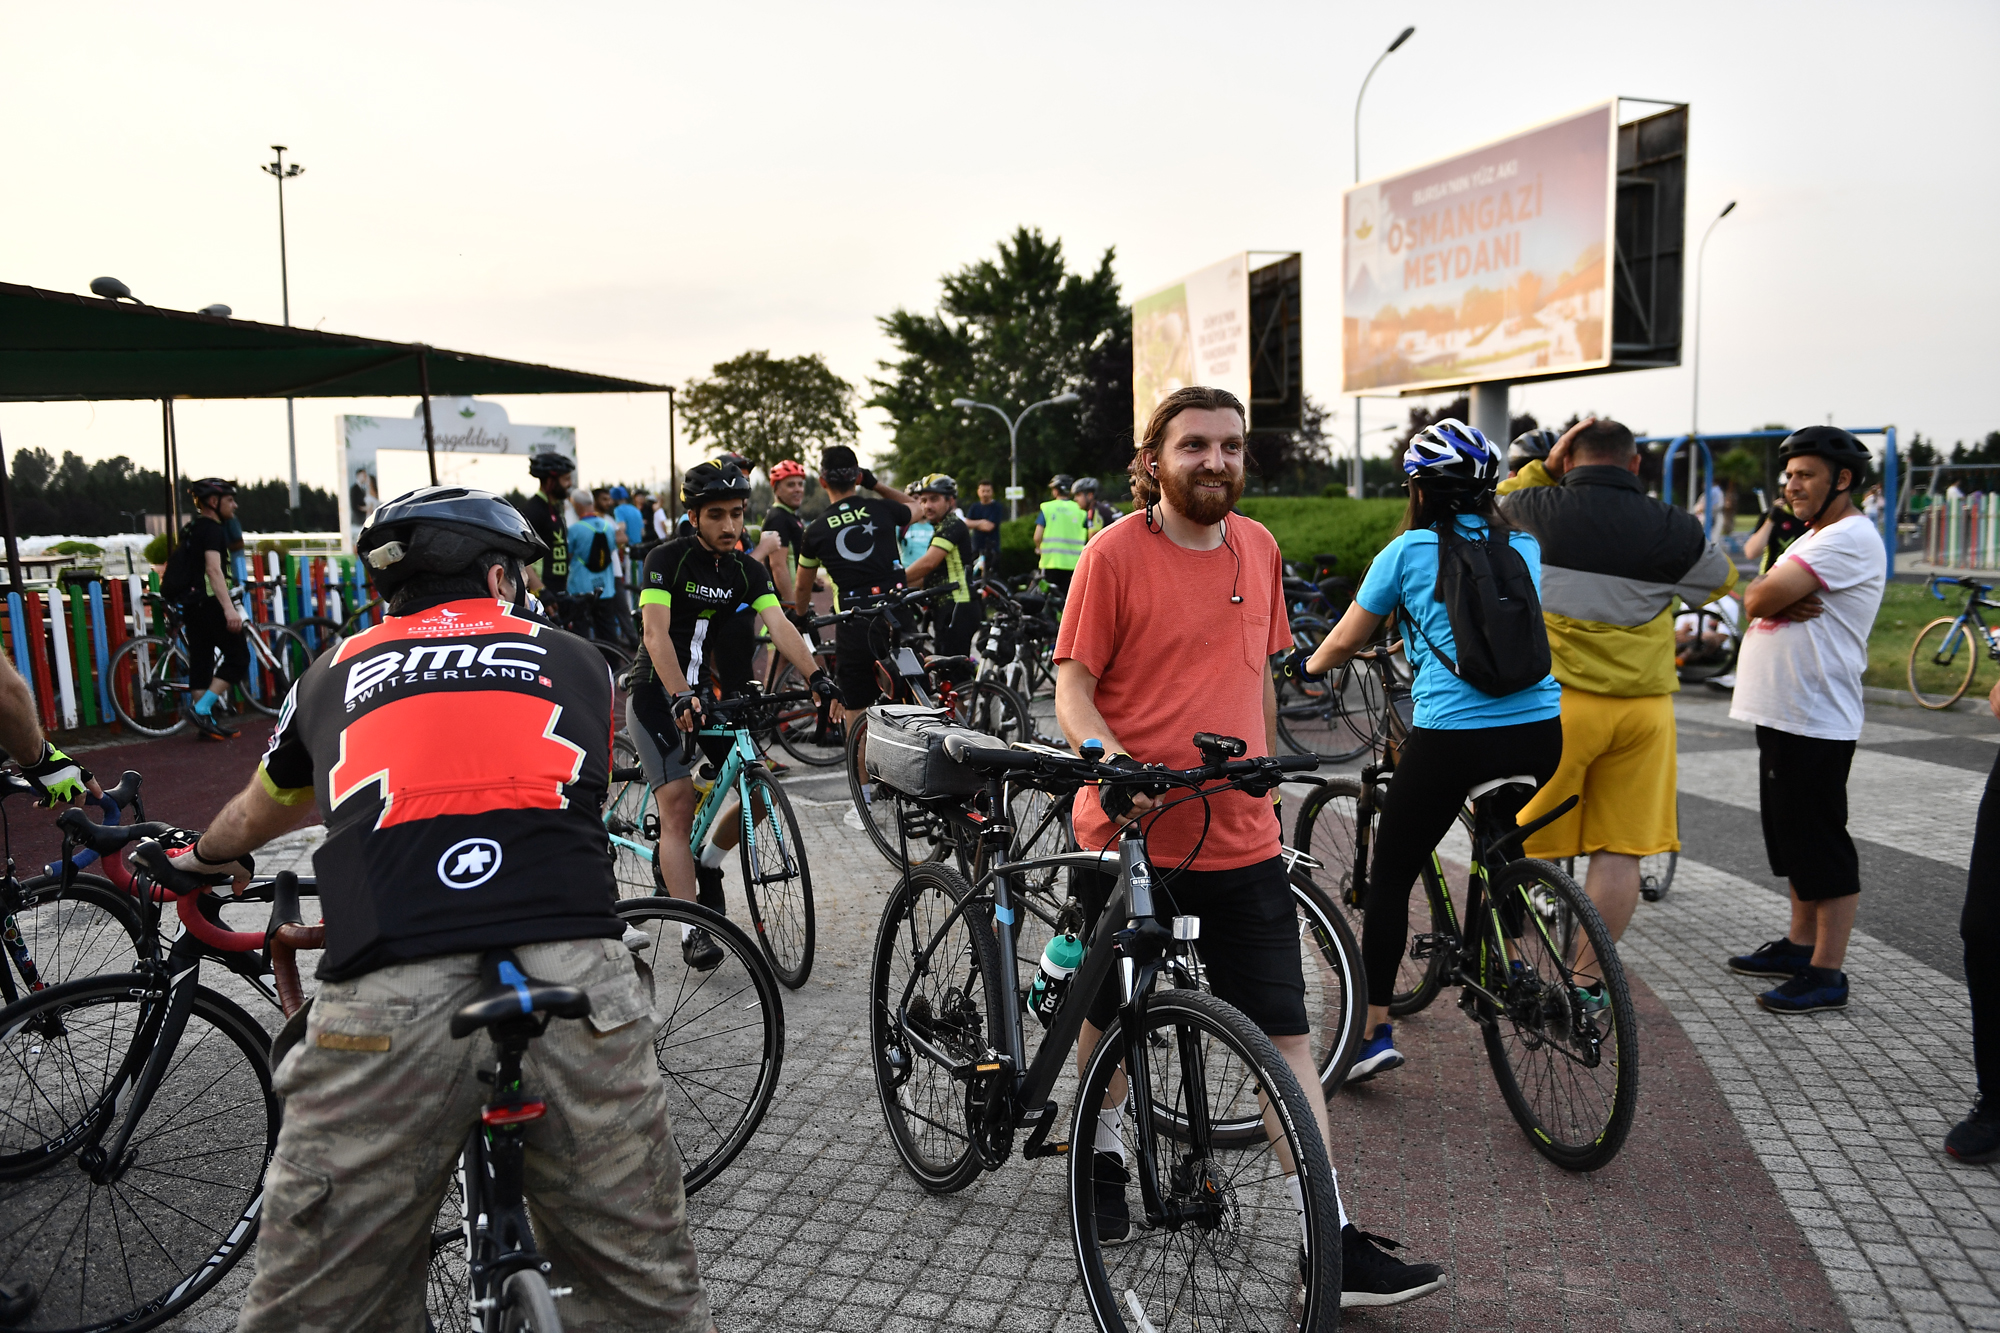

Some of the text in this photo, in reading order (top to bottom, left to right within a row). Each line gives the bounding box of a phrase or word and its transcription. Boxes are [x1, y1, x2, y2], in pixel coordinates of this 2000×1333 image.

[1387, 172, 1543, 255] OSMANGAZİ
[1403, 231, 1521, 291] MEYDANI
[826, 506, 871, 529] BBK
[552, 529, 567, 575] BBK
[344, 642, 548, 703] BMC
[346, 668, 535, 713] SWITZERLAND
[1292, 1131, 1305, 1160] CROSS
